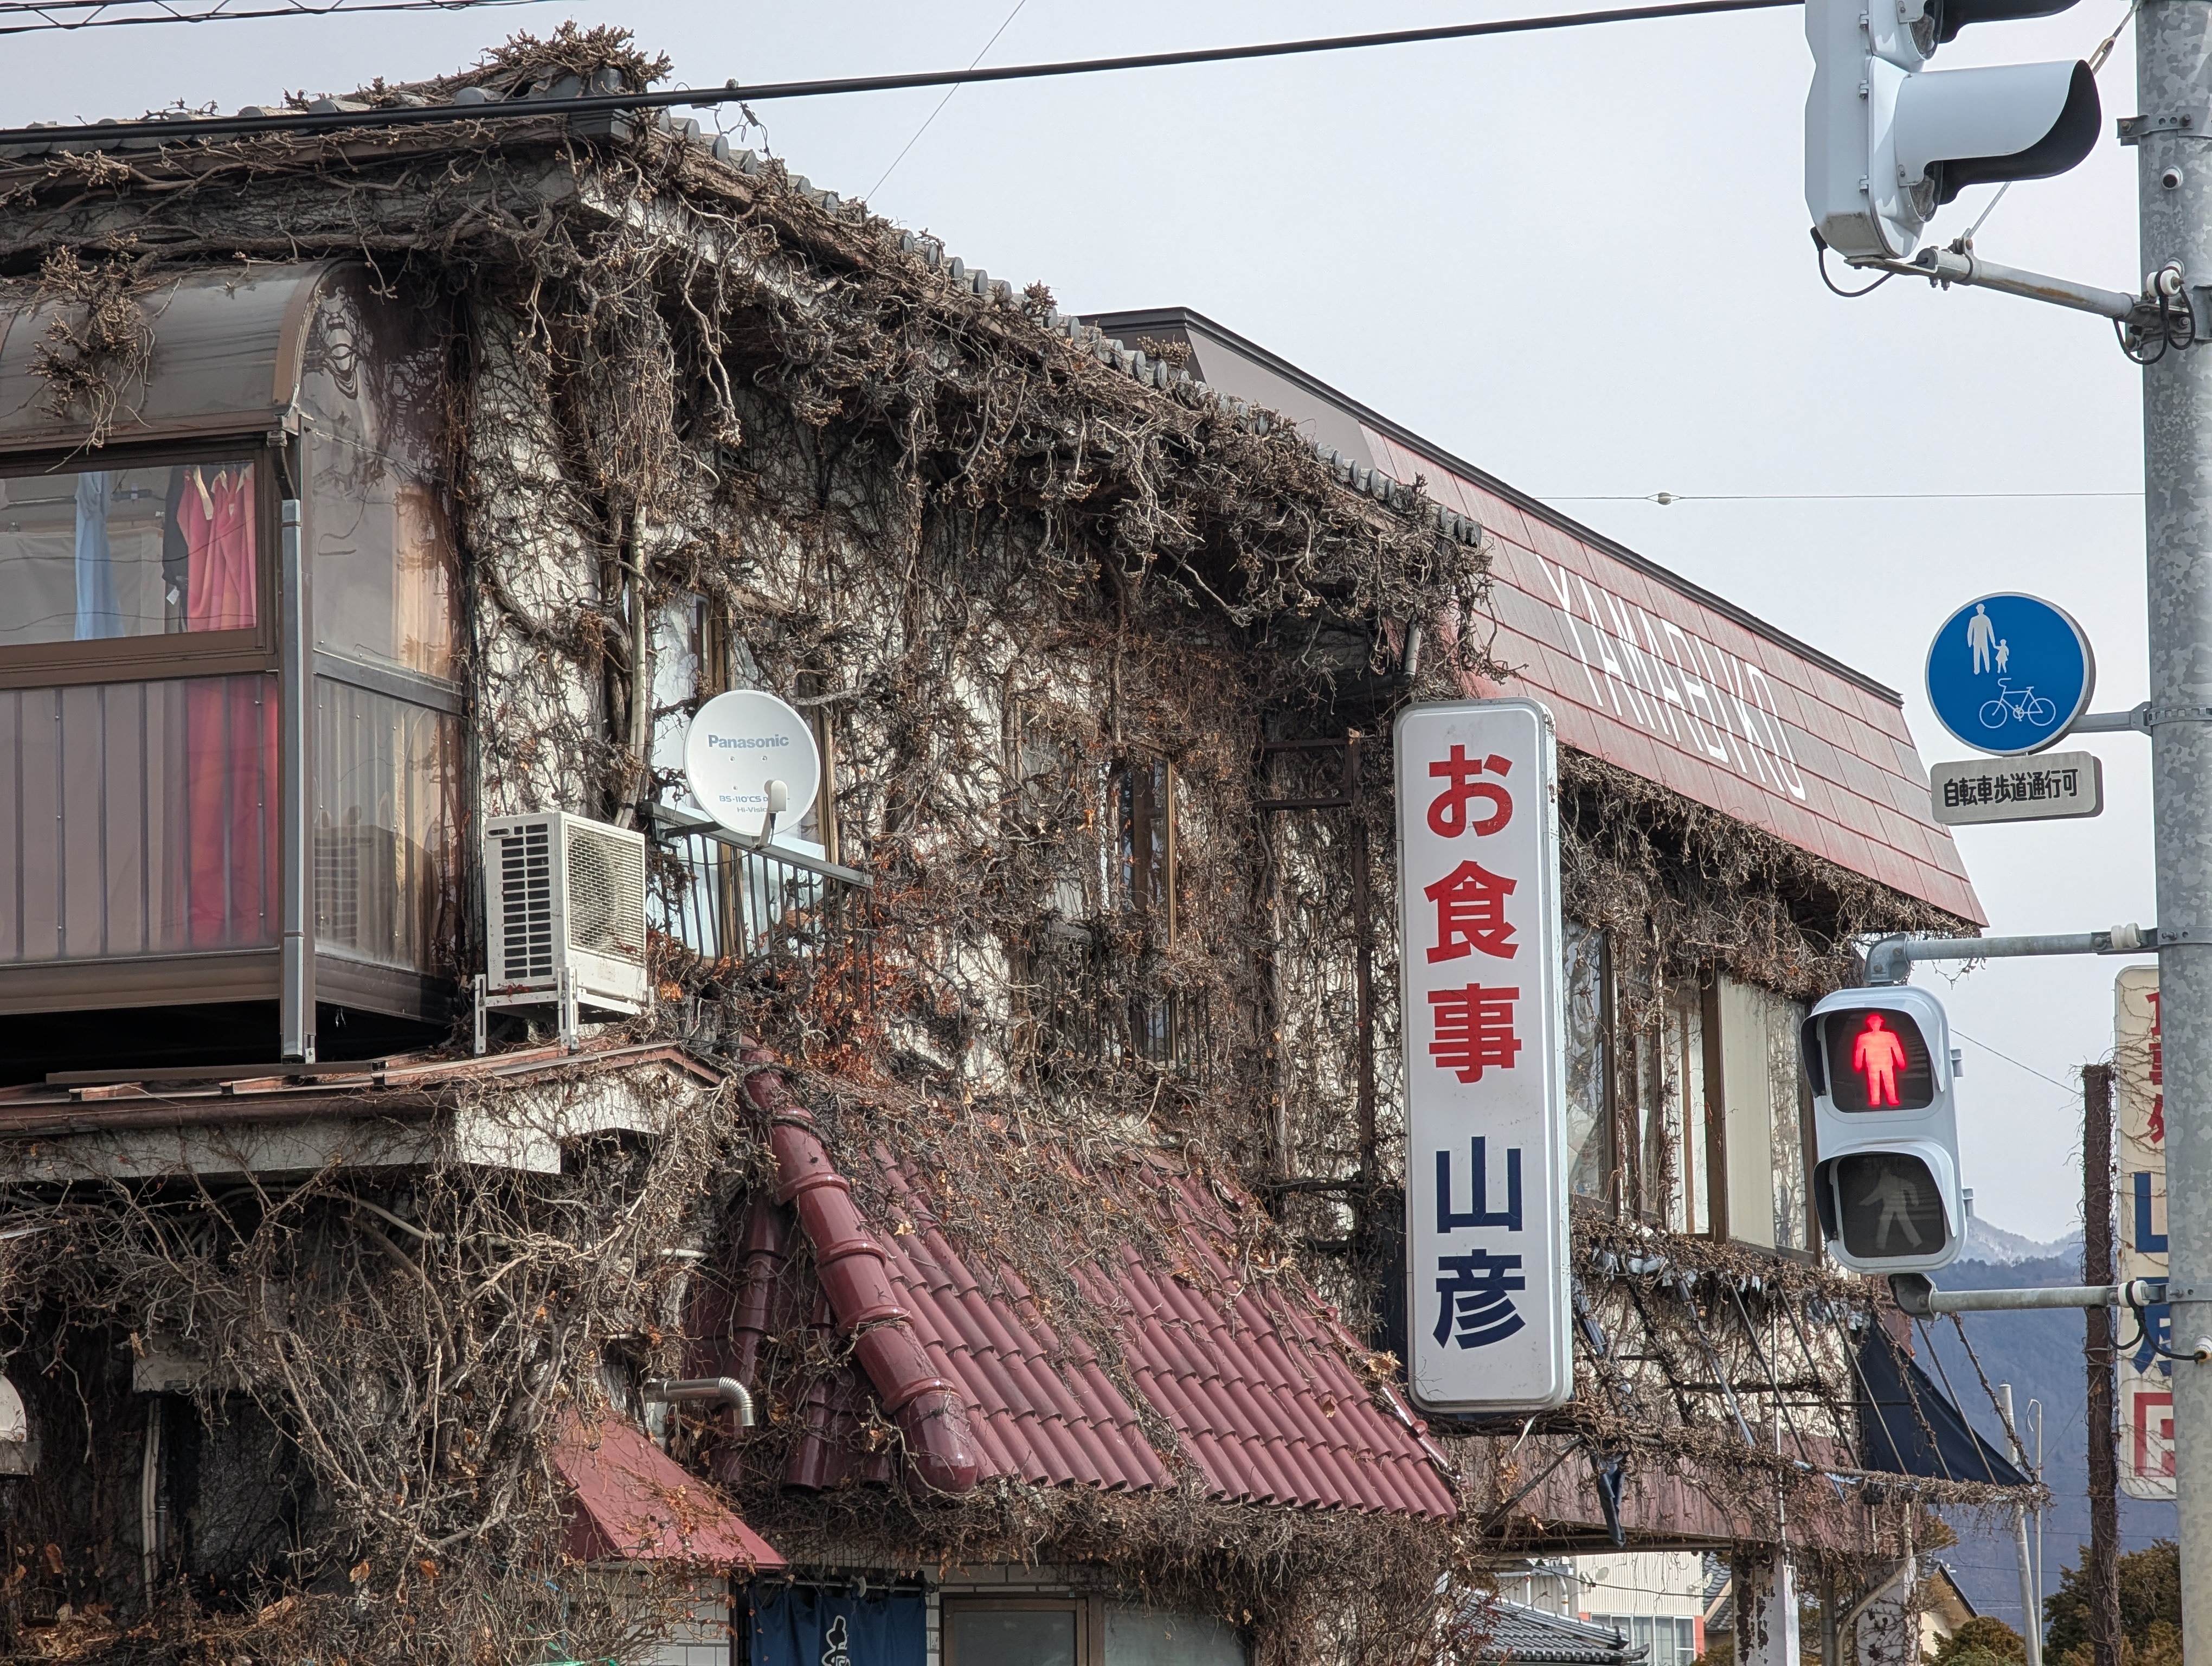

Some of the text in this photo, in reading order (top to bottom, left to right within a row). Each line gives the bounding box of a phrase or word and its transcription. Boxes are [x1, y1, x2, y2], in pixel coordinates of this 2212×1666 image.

[709, 734, 789, 748] Panasonic
[1535, 553, 1805, 800] YAMABIKO
[1944, 768, 2078, 807] 自転車歩道通行可
[1425, 746, 1525, 1350] お食事 山彦
